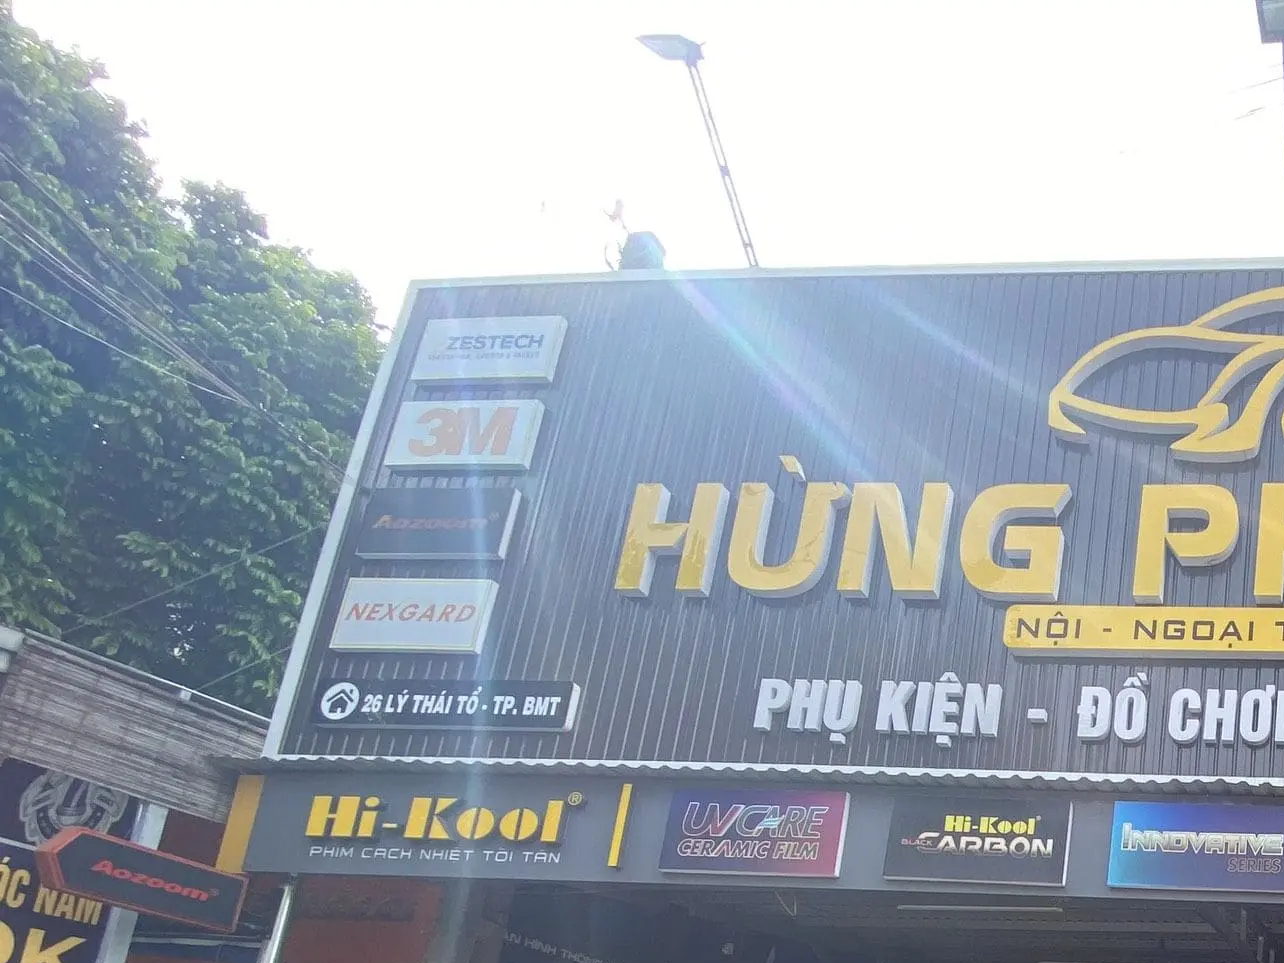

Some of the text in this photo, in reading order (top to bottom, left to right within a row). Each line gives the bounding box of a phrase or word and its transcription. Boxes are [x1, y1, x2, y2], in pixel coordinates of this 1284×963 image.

[446, 333, 545, 350] ZESTECH
[408, 406, 520, 457] 3M
[345, 602, 477, 624] NEXGARD
[1016, 611, 1081, 646] NỘI
[1133, 618, 1255, 649] NGOẠI
[361, 694, 381, 713] 26
[385, 689, 409, 713] LÝ
[411, 689, 452, 714] THÁI
[521, 696, 561, 716] BMT
[753, 678, 863, 745] PHỤ
[875, 671, 1003, 748] KIỆN
[1077, 672, 1150, 744] ĐỒ
[309, 846, 354, 859] PHIM
[677, 838, 820, 861] CERAMIC FILM
[1226, 857, 1281, 874] SERIES
[90, 859, 211, 902] Aozoom
[32, 887, 104, 926] NAM
